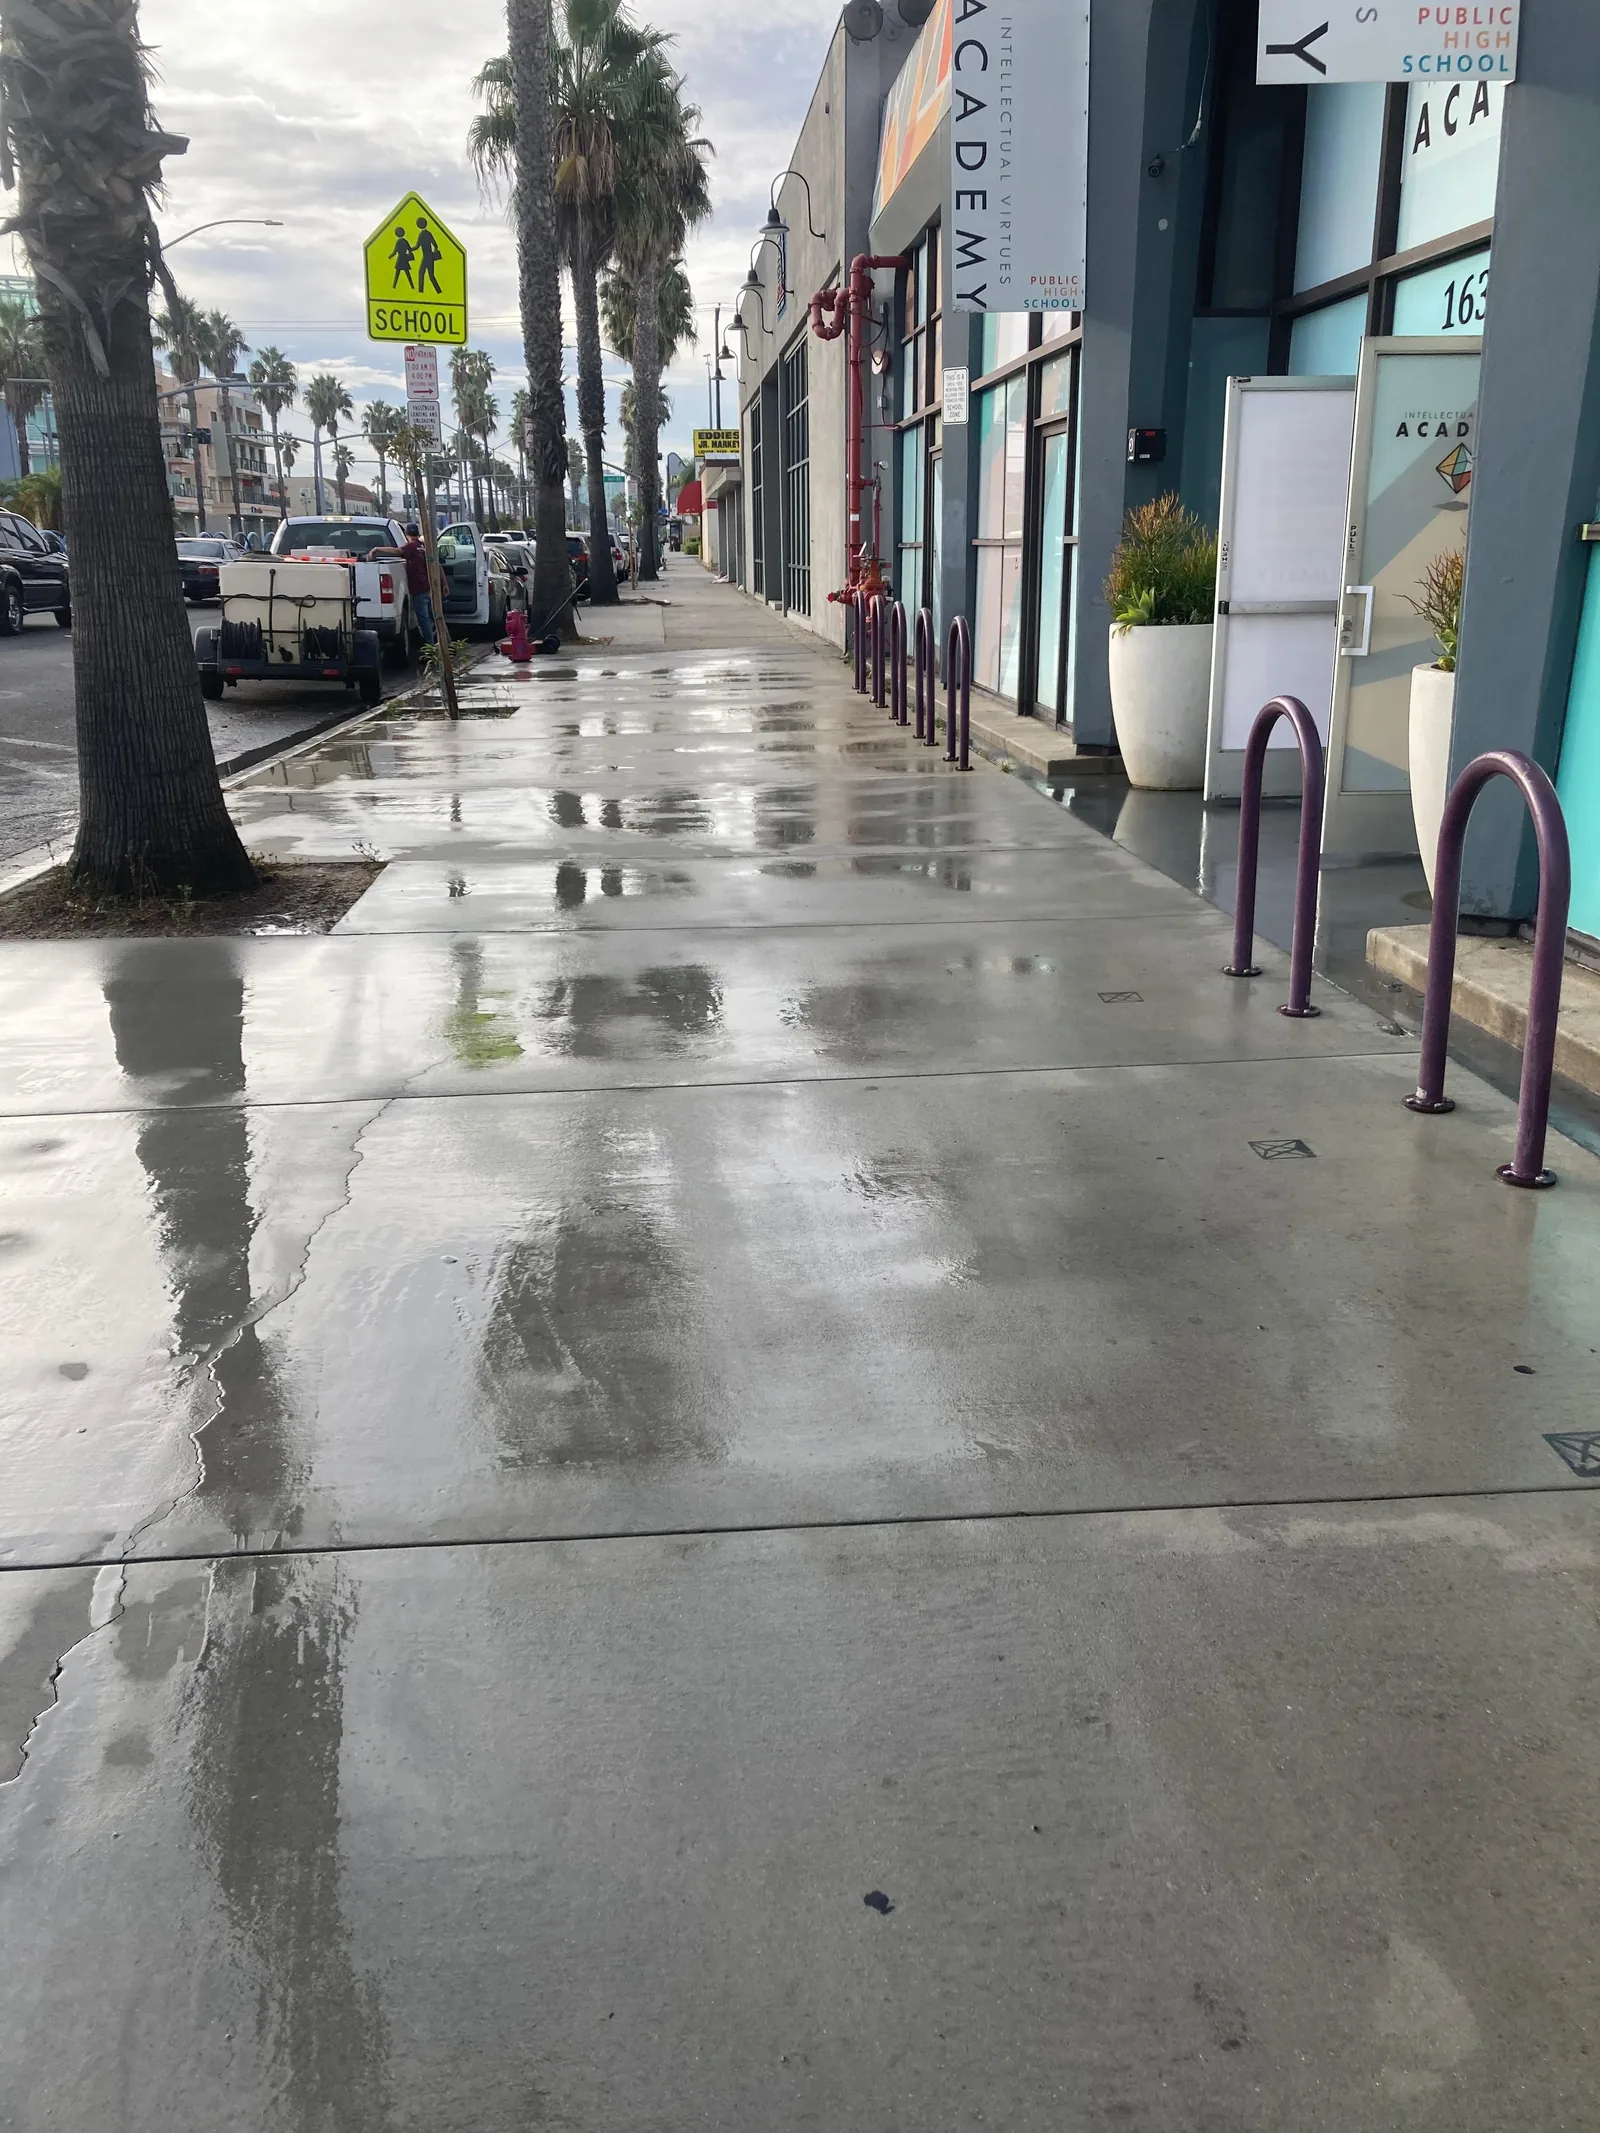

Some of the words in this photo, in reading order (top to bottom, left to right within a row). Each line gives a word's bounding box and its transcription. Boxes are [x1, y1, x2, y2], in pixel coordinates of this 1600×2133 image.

[1417, 6, 1513, 25] PUBLIC
[1443, 30, 1512, 50] HIGH
[1401, 54, 1509, 74] SCHOOL
[1000, 17, 1012, 181] INTELLECTUAL
[954, 0, 988, 309] ACADEMY
[999, 195, 1011, 284] VIRTUES
[1030, 275, 1078, 286] PUBLIC
[1043, 286, 1078, 297] HIGH
[1023, 298, 1078, 309] SCHOOL
[374, 307, 461, 336] SCHOOL
[405, 348, 415, 361] NO
[420, 363, 428, 371] AM
[429, 363, 436, 371] TO
[946, 403, 963, 411] SCHOOL
[697, 431, 740, 440] EDDIES
[1395, 421, 1470, 438] ACAD
[698, 440, 710, 449] JR.
[1349, 525, 1357, 549] PULL
